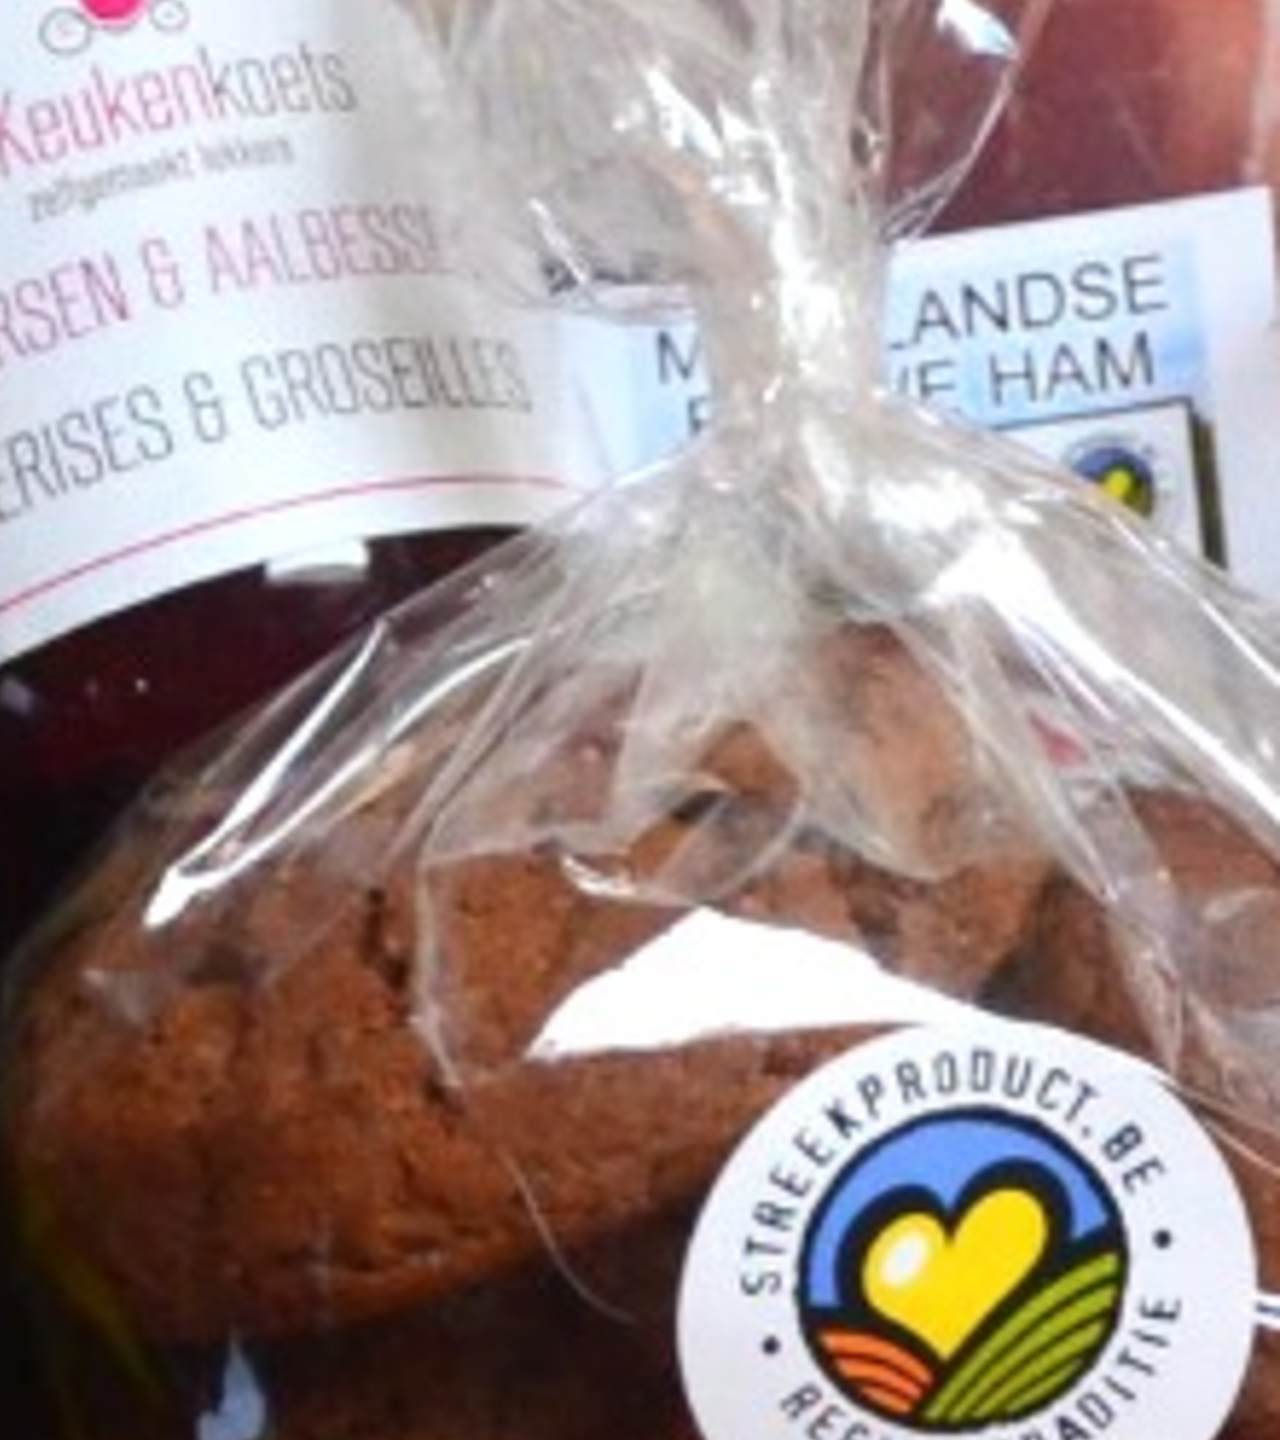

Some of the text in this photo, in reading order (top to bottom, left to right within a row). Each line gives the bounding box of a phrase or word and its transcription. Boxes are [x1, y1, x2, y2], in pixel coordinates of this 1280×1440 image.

[141, 235, 189, 312] &
[182, 370, 231, 446] &
[243, 336, 533, 435] GROSEILLES
[990, 332, 1155, 406] HAM
